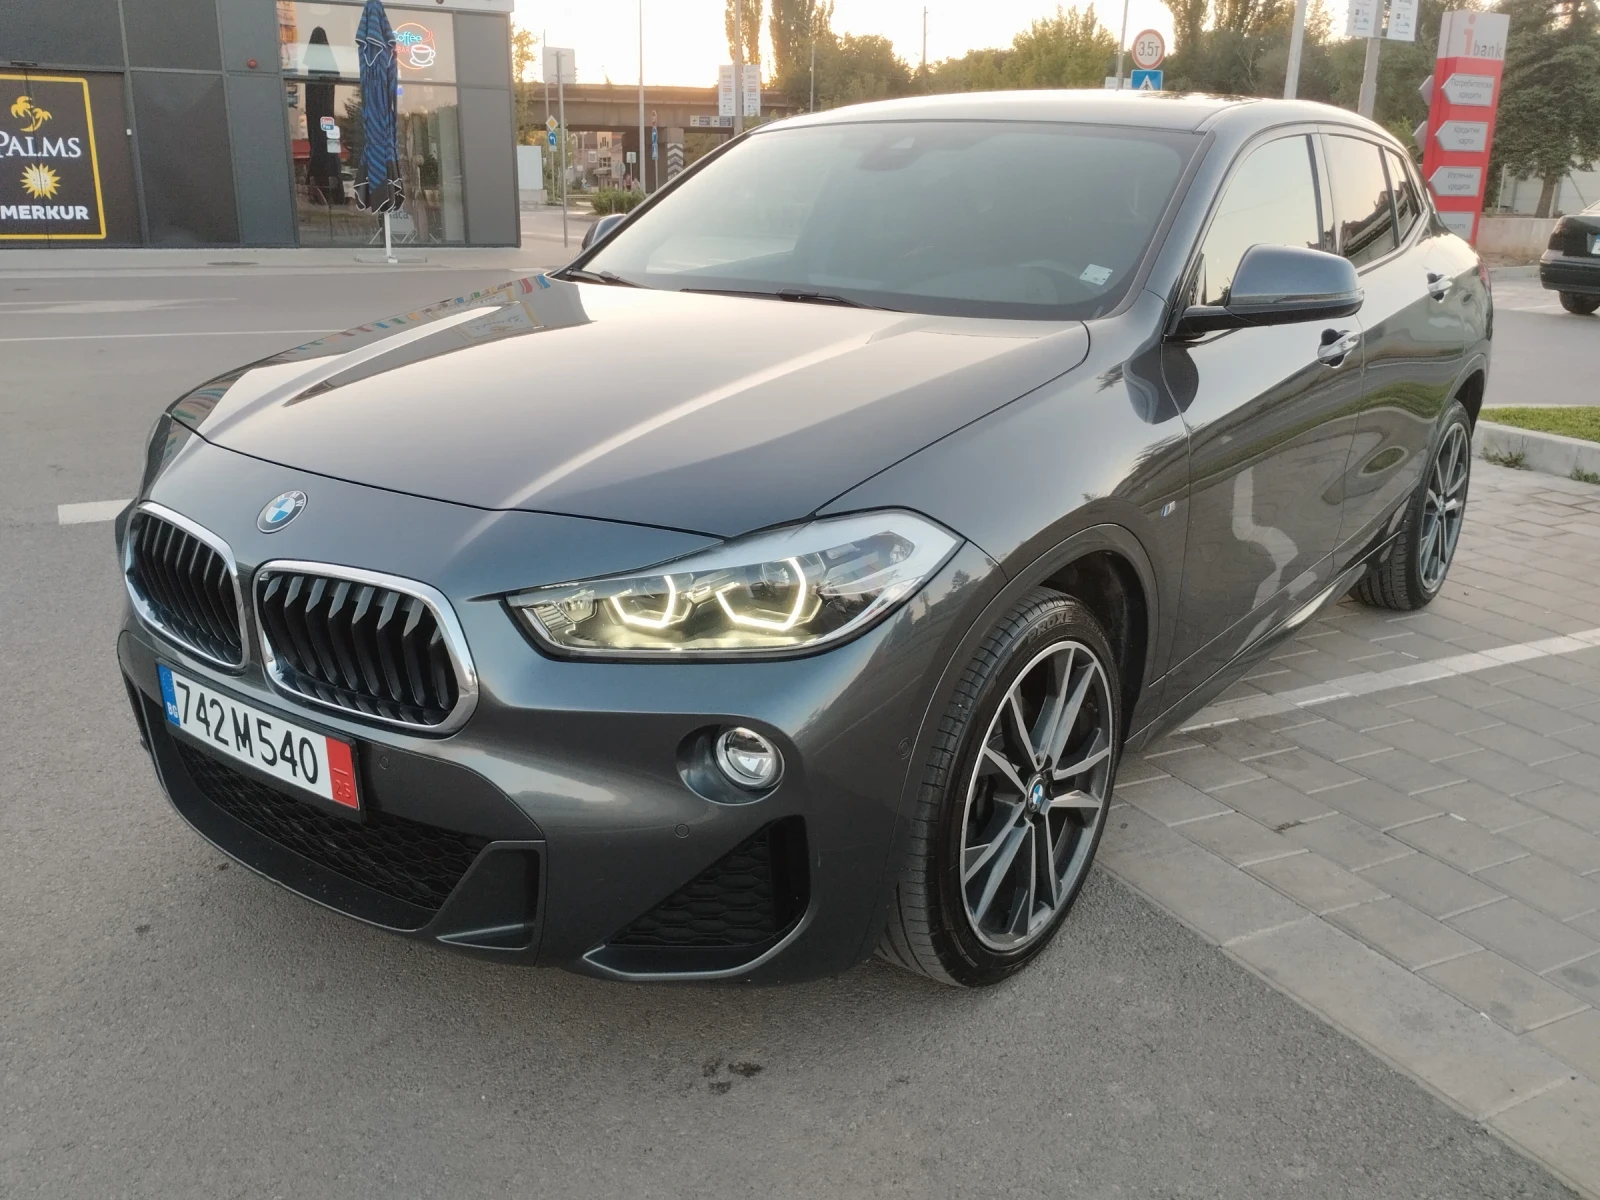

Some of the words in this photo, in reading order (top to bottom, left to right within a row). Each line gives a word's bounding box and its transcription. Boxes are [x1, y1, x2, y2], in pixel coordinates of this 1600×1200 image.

[0, 205, 90, 220] MERKUR
[166, 701, 179, 719] BG
[175, 680, 318, 785] 742M540
